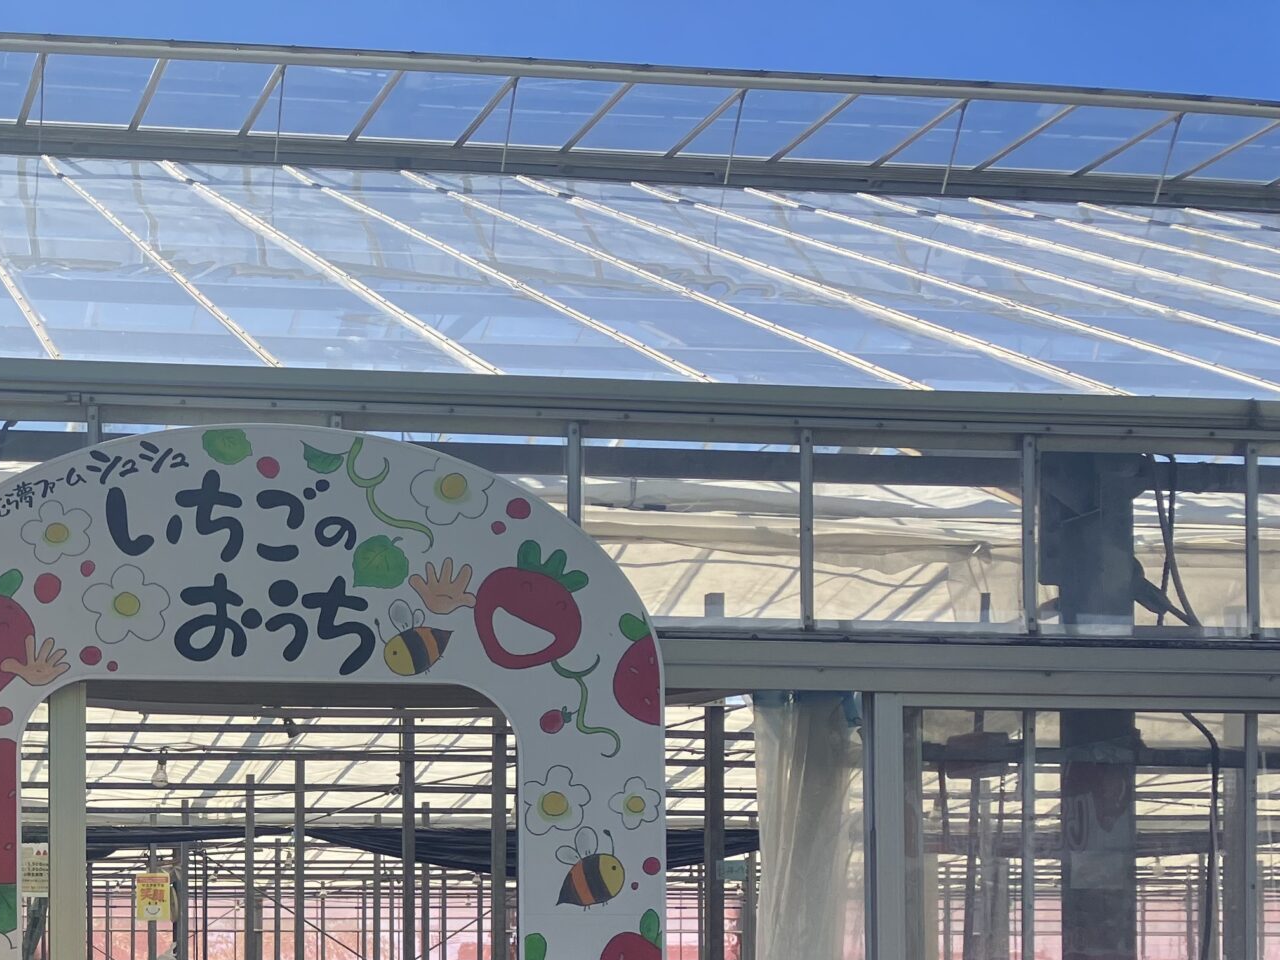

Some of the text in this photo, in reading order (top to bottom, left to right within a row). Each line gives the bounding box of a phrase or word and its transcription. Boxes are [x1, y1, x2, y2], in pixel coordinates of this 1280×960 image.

[104, 469, 357, 563] いちごの
[173, 572, 377, 676] おうち
